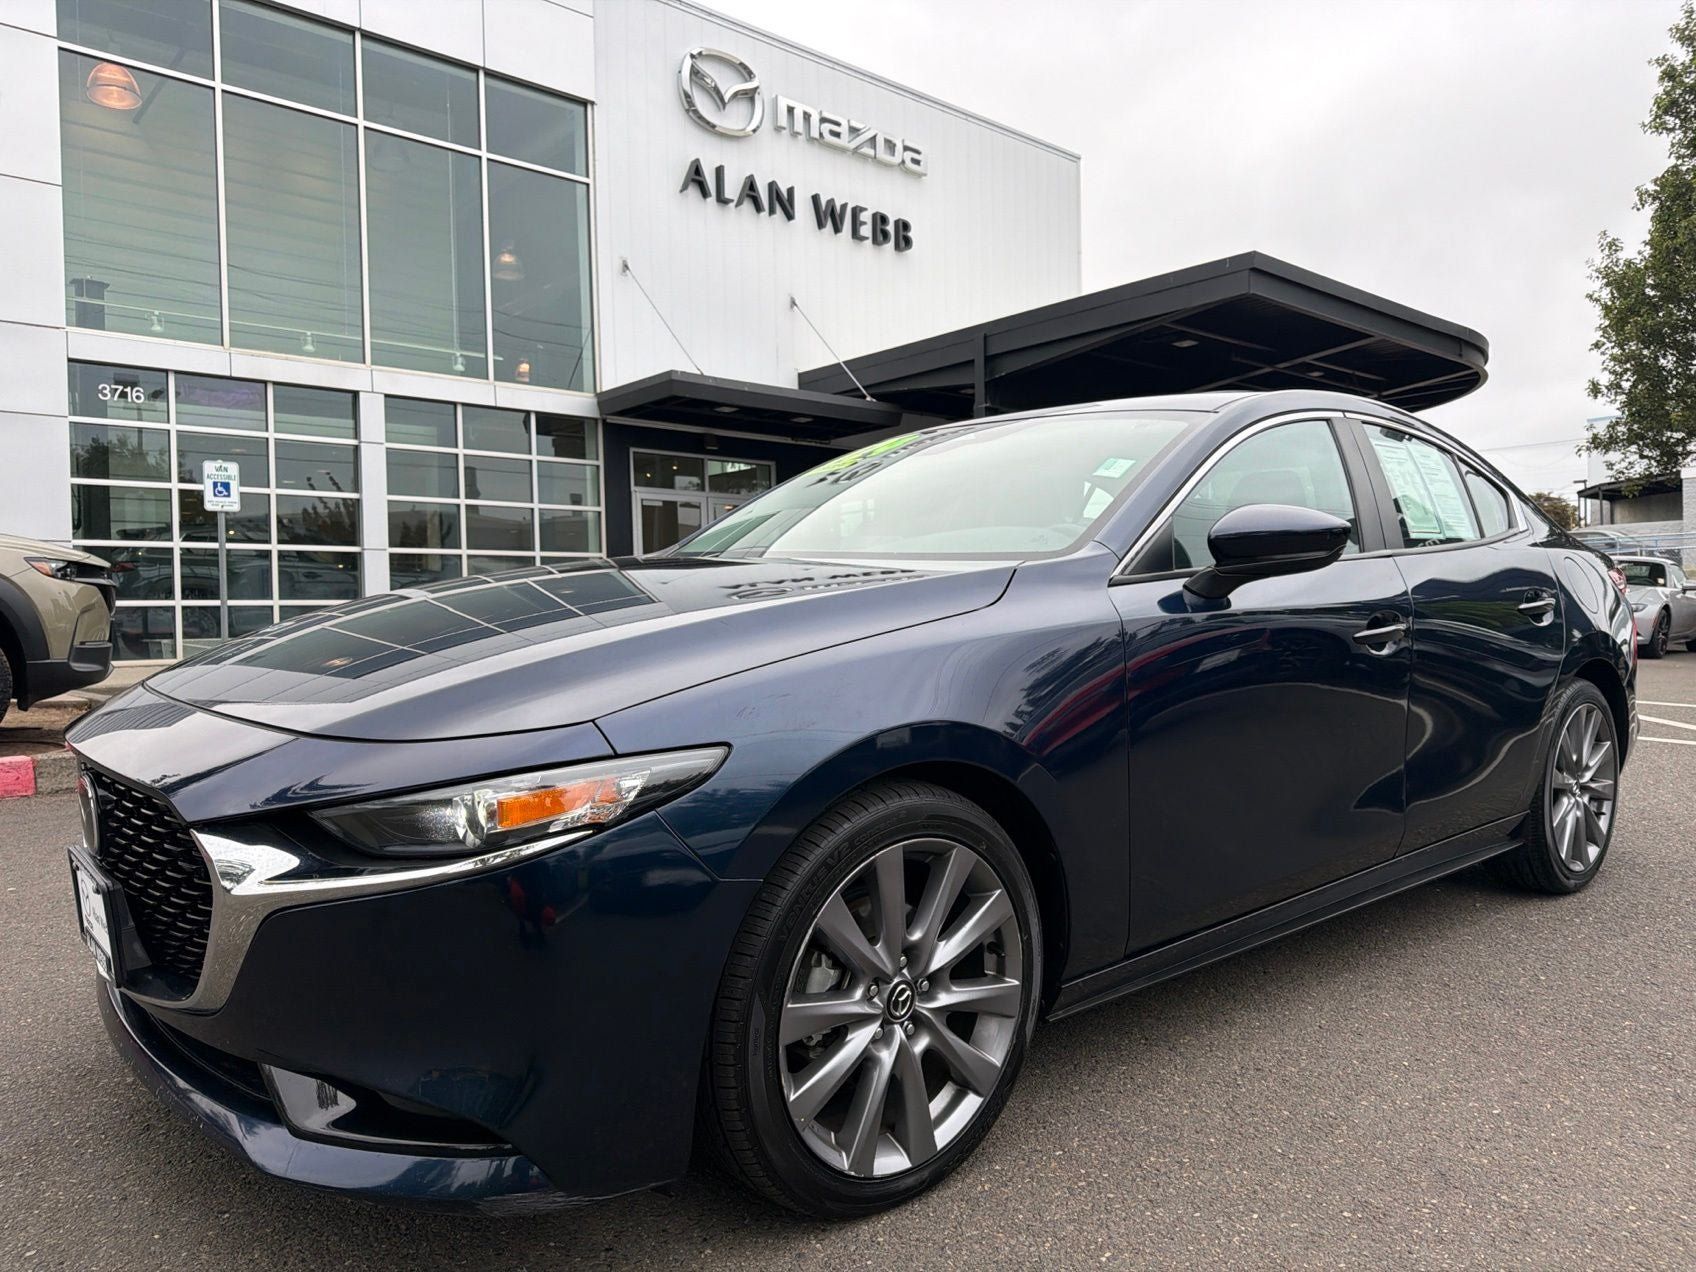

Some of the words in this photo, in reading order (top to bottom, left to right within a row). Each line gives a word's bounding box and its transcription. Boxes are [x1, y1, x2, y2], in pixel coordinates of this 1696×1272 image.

[773, 94, 927, 178] mazda
[679, 157, 796, 222] ALAN
[811, 192, 914, 253] WEBB
[97, 384, 145, 404] 3716
[206, 472, 237, 482] ACCESSIBLE
[214, 464, 229, 473] VAN
